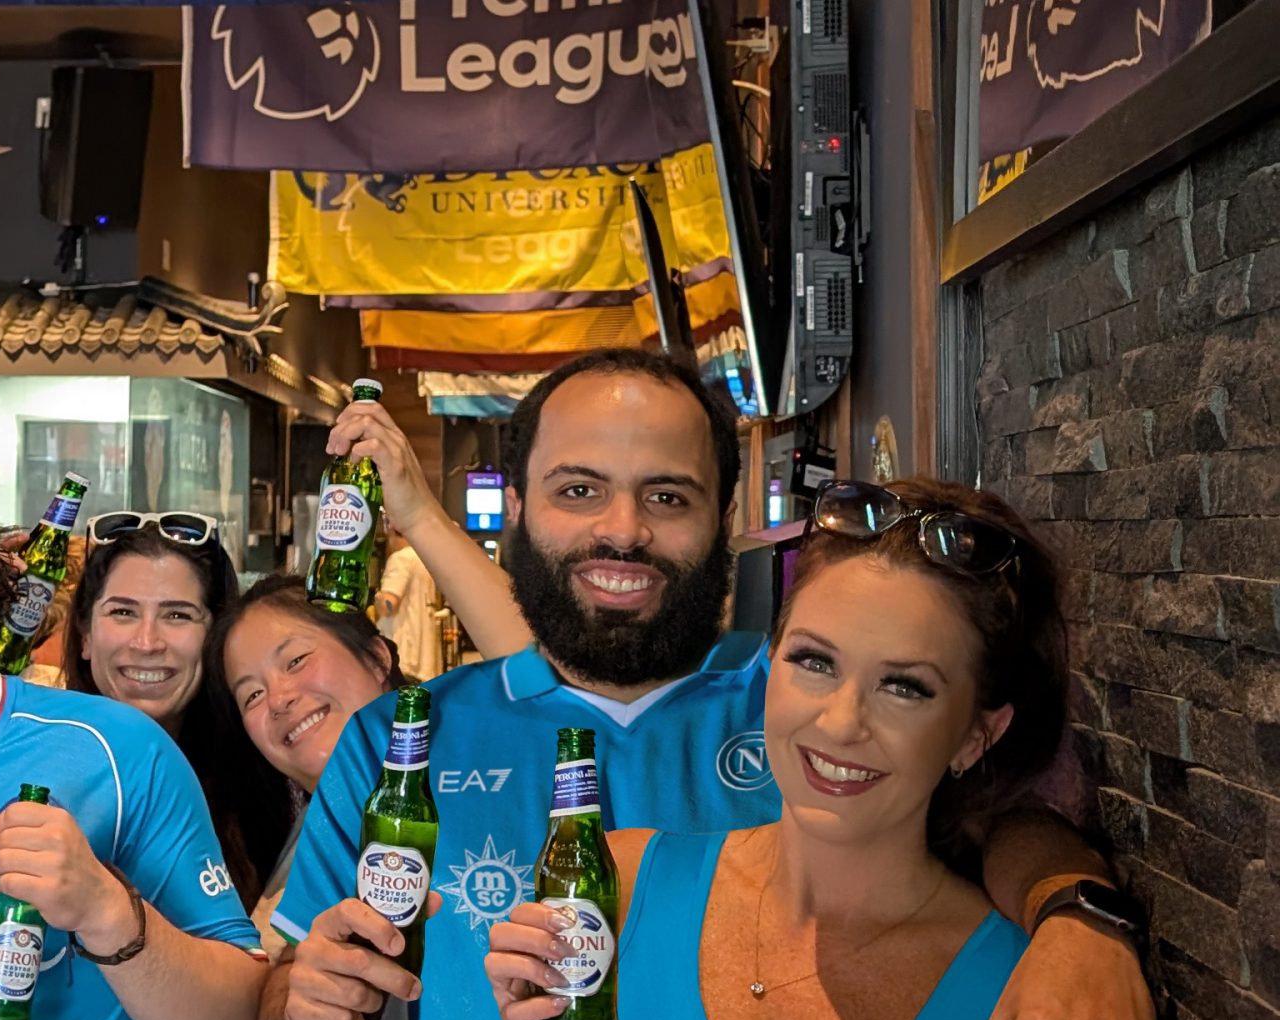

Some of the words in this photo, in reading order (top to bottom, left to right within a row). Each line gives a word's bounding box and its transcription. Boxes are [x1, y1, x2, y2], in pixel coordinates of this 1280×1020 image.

[400, 20, 660, 104] Leagu
[318, 507, 365, 523] PERONI
[392, 730, 420, 740] PERONI
[438, 768, 513, 793] EA7
[554, 769, 584, 784] PERONI
[362, 865, 424, 891] PERONI
[367, 890, 415, 904] AZZURRO
